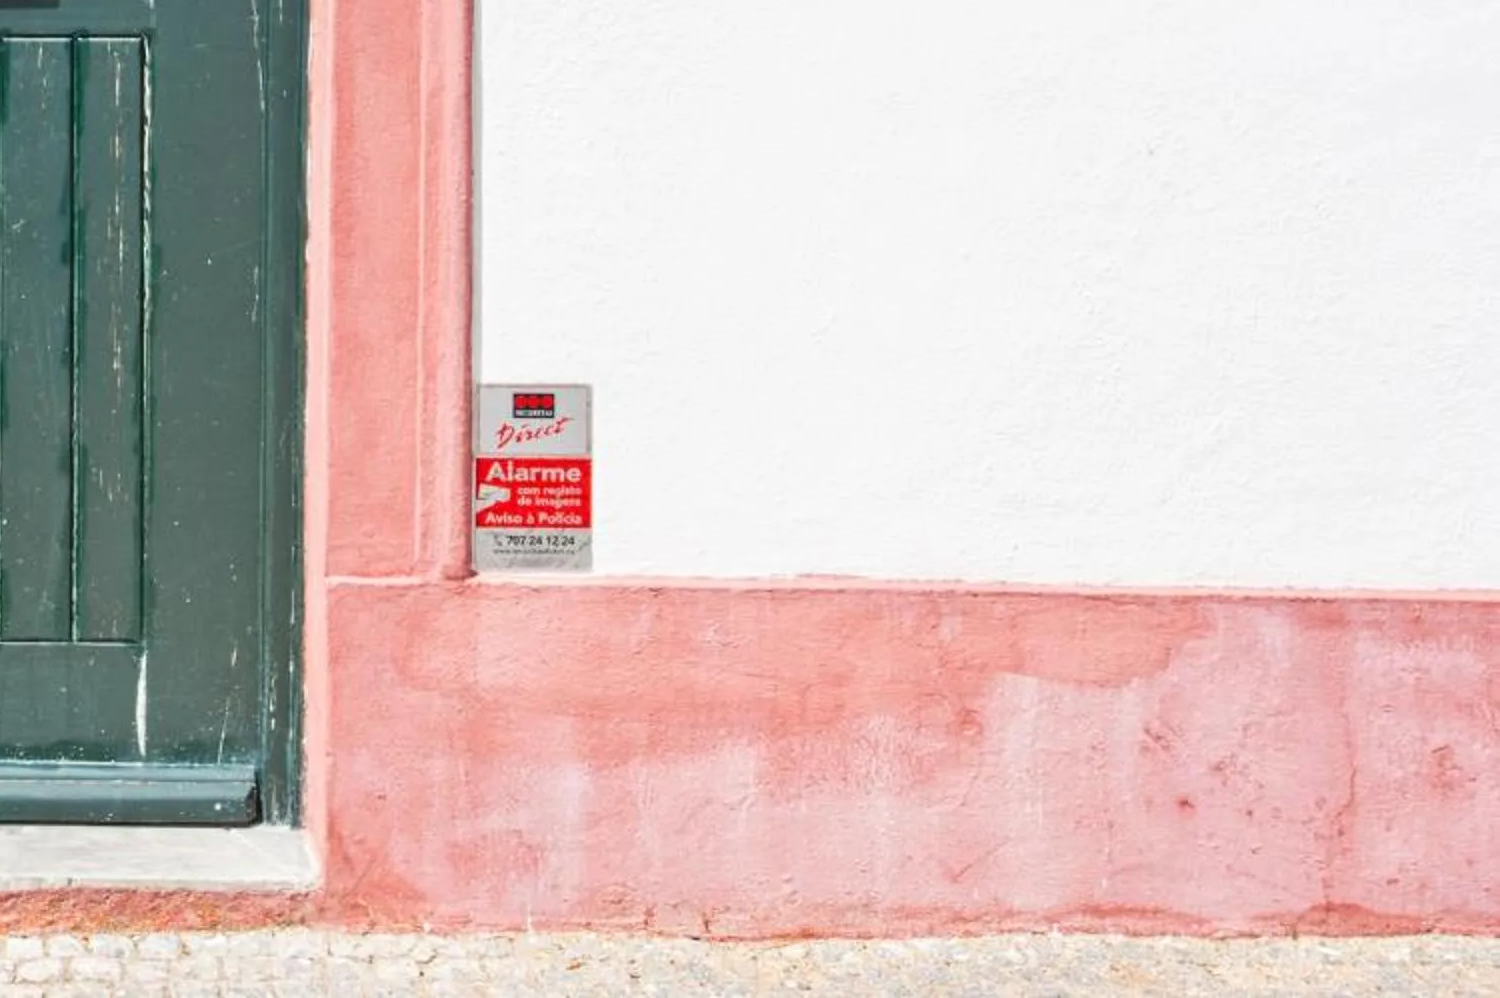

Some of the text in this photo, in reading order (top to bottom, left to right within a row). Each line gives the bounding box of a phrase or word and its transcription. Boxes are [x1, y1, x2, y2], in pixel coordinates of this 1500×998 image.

[496, 416, 573, 449] Direct
[486, 460, 581, 483] Alarme
[517, 486, 541, 496] com
[517, 496, 532, 506] de
[484, 511, 523, 525] Aviso
[538, 510, 582, 525] Polícia
[528, 535, 543, 546] 24
[546, 535, 560, 547] 12
[561, 535, 575, 547] 24
